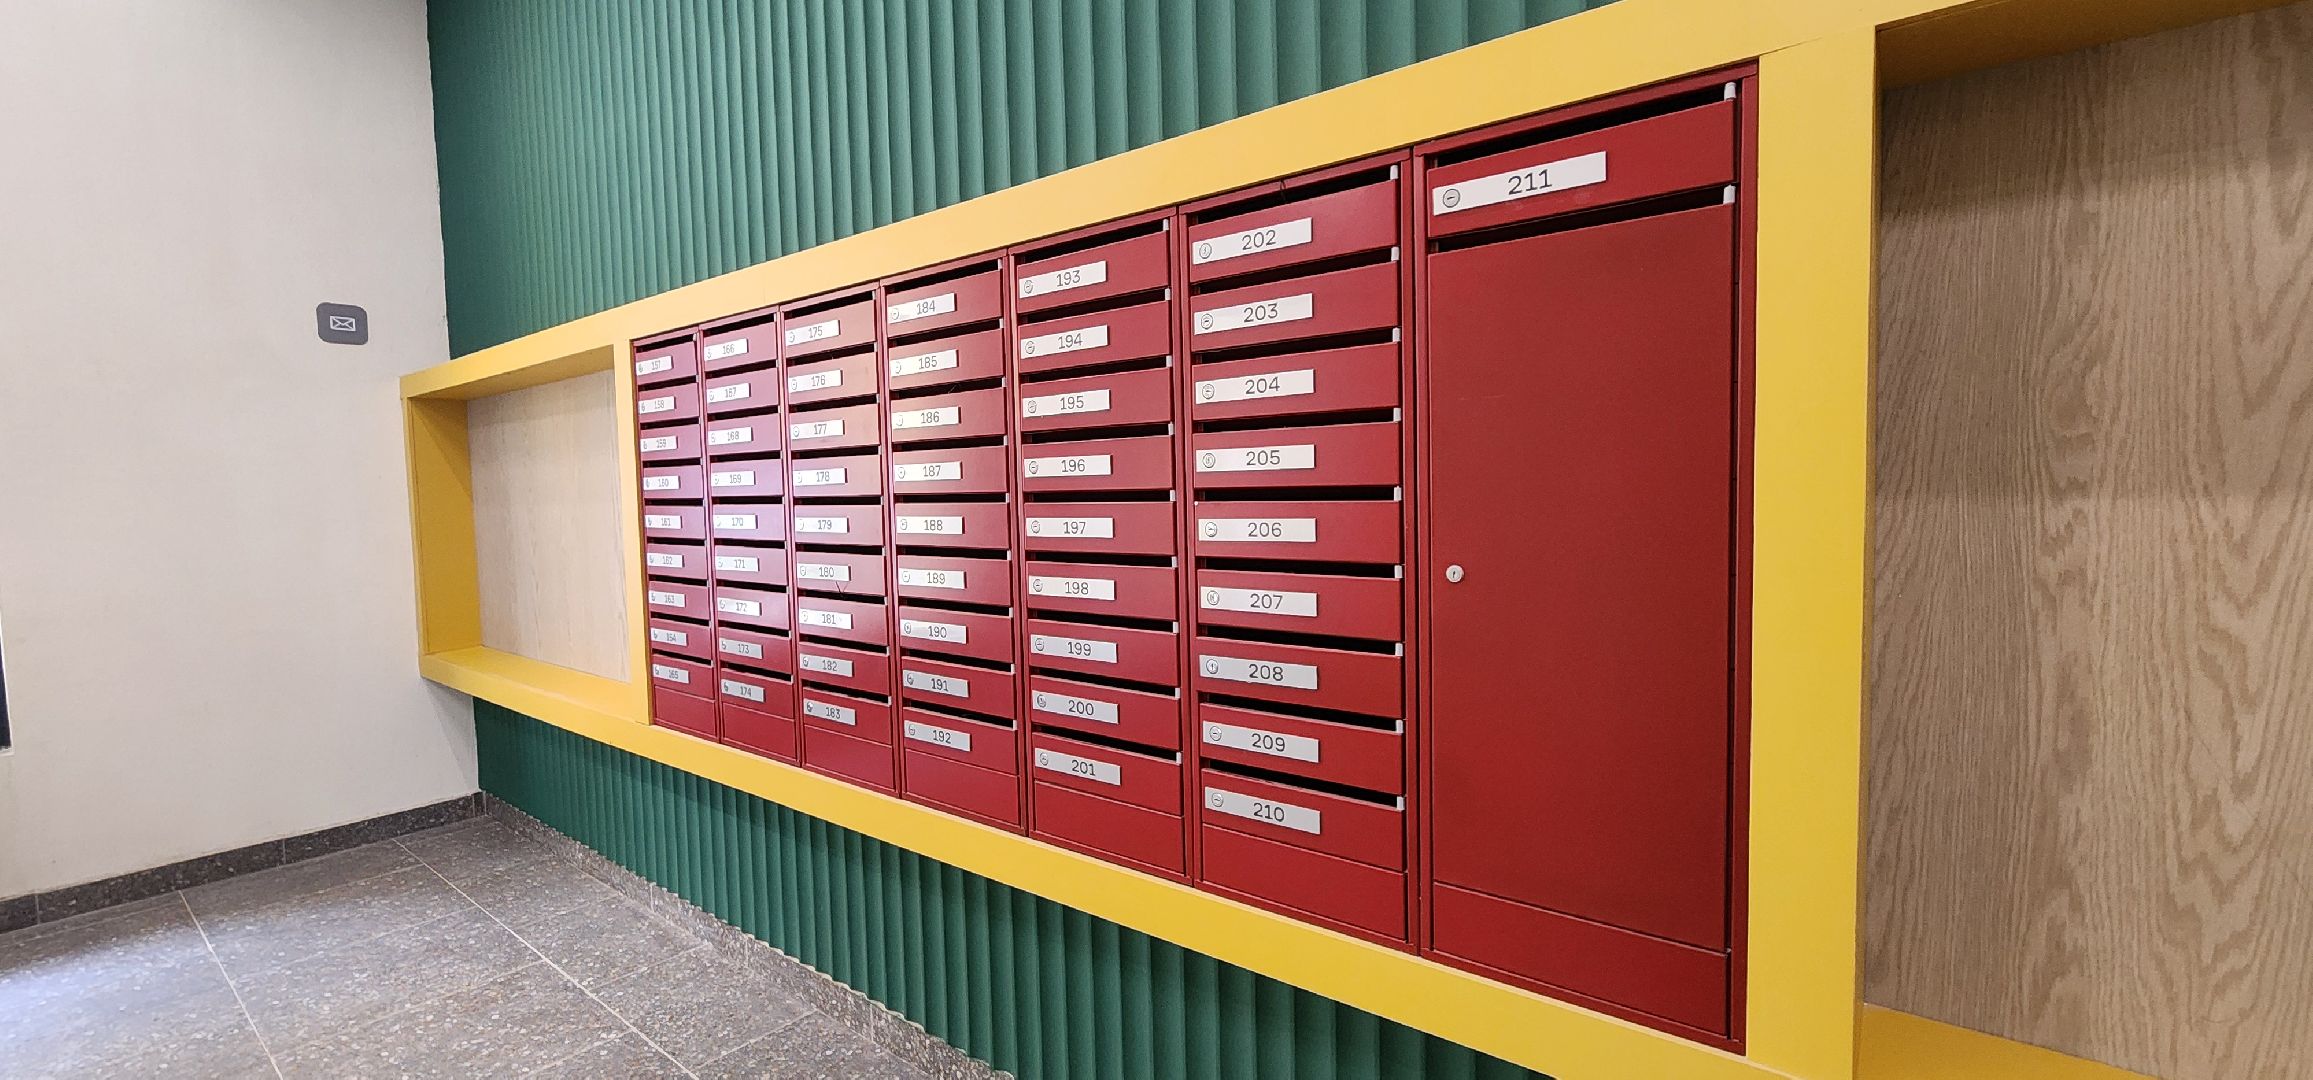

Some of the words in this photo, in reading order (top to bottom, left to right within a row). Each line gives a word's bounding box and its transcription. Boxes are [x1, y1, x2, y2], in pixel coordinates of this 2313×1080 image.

[1508, 169, 1552, 195] 211
[1242, 230, 1276, 250] 202
[1057, 270, 1080, 287] 193
[917, 300, 936, 316] 184
[1244, 303, 1277, 322] 203
[809, 326, 822, 338] 175
[1058, 333, 1082, 349] 194
[919, 356, 937, 369] 185
[1245, 377, 1280, 394] 204
[1060, 396, 1084, 410] 195
[921, 411, 939, 423] 186
[814, 424, 827, 434] 177
[1246, 450, 1280, 465] 205
[923, 465, 941, 477] 187
[1062, 459, 1085, 472] 196
[817, 471, 830, 482] 178
[818, 520, 832, 530] 179
[924, 520, 943, 531] 188
[1064, 522, 1085, 534] 197
[1248, 523, 1281, 537] 206
[819, 567, 834, 577] 180
[927, 572, 945, 584] 189
[1065, 582, 1088, 595] 198
[1251, 593, 1283, 609] 207
[822, 614, 836, 624] 181
[928, 626, 947, 638] 190
[1068, 642, 1091, 656] 199
[823, 660, 837, 671] 182
[1249, 664, 1283, 681] 208
[931, 678, 948, 692] 191
[826, 707, 840, 719] 183
[1069, 700, 1094, 715] 200
[933, 730, 951, 744] 192
[1252, 733, 1285, 752] 209
[1072, 760, 1095, 776] 201
[1254, 803, 1284, 822] 210
